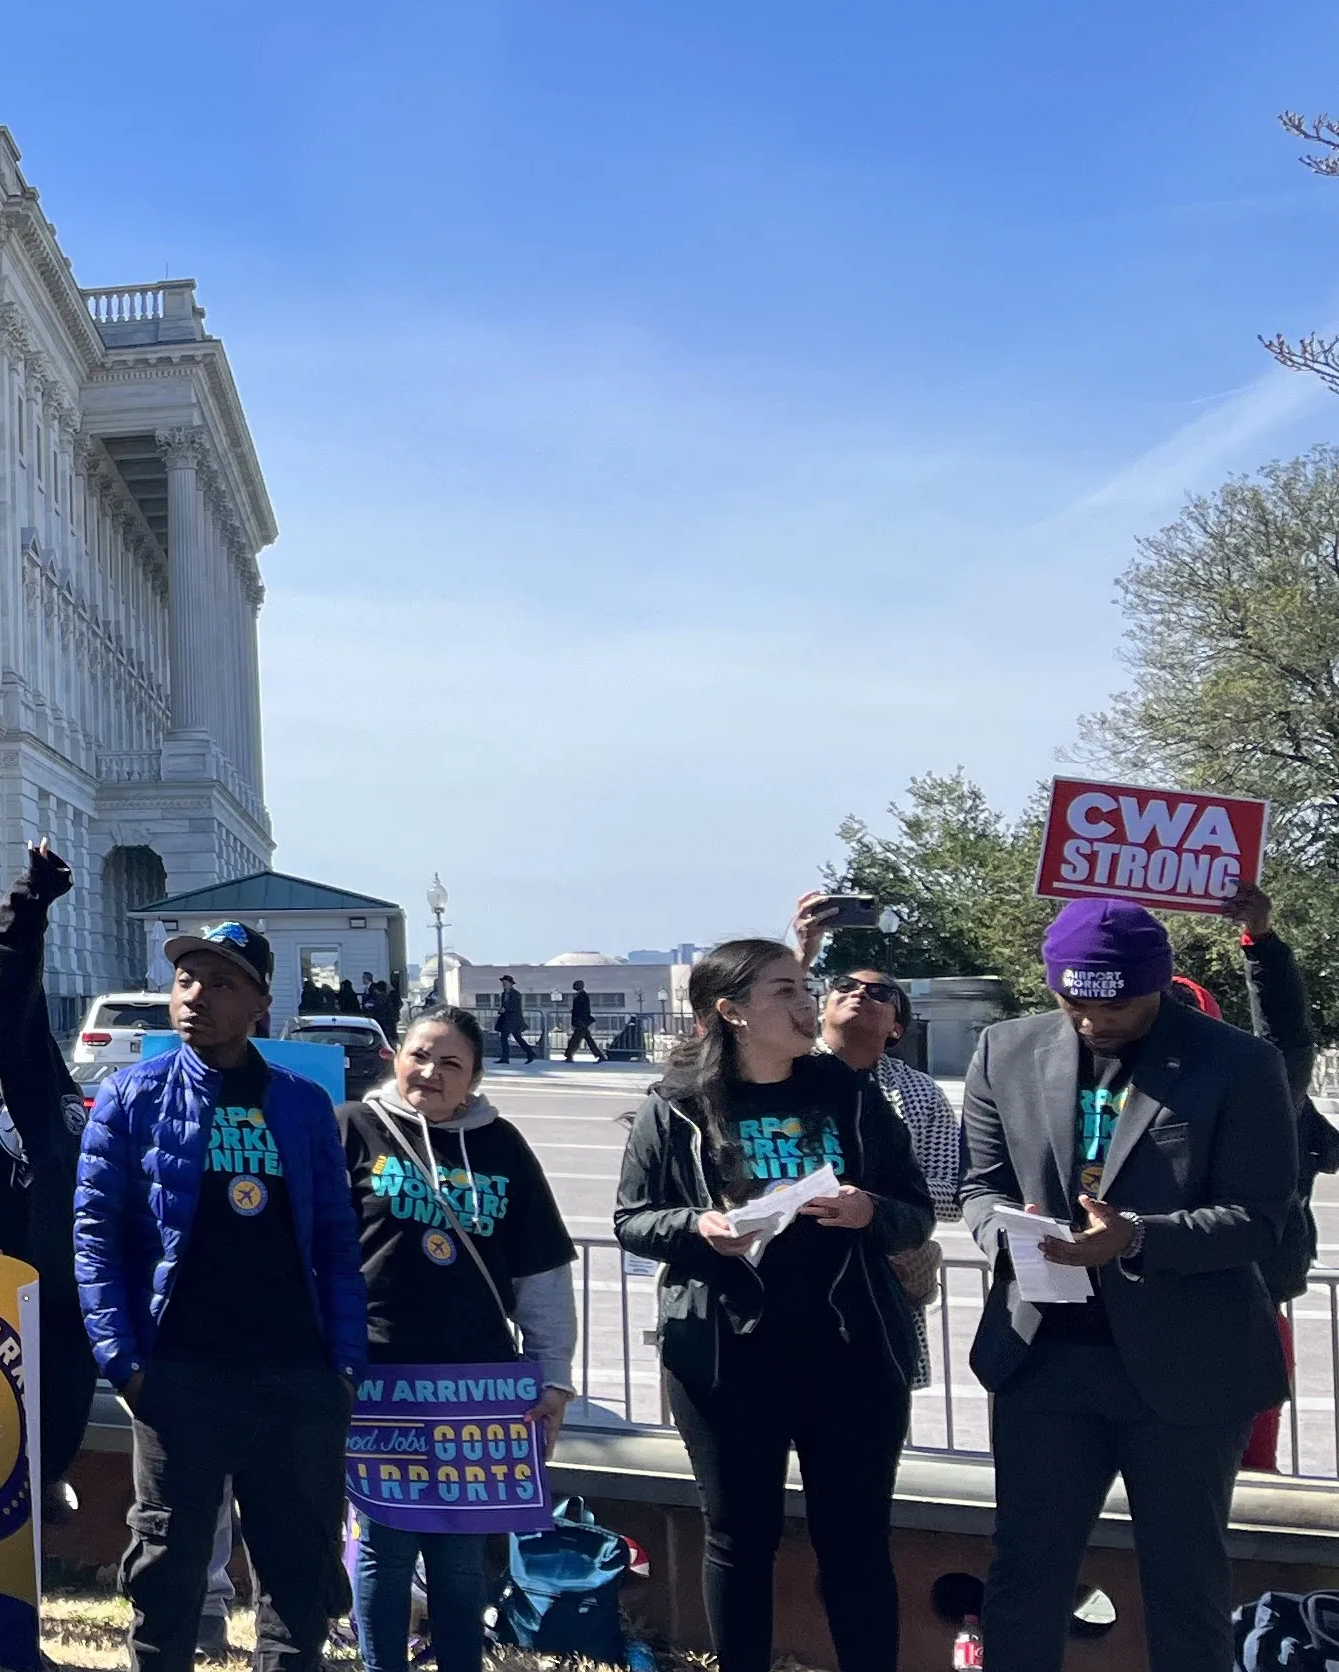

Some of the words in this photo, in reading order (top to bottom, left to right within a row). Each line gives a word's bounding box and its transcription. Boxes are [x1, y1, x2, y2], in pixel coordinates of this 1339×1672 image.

[1066, 791, 1242, 855] CWA
[1060, 839, 1241, 899] STRONG
[1063, 969, 1122, 980] AIRPORT
[1063, 978, 1125, 989] WORKERS
[1070, 987, 1117, 998] UNITED
[391, 1377, 538, 1403] ARRIVING
[380, 1428, 429, 1452] Jobs
[433, 1423, 530, 1461] GOOD
[346, 1463, 535, 1502] IRPORTS
